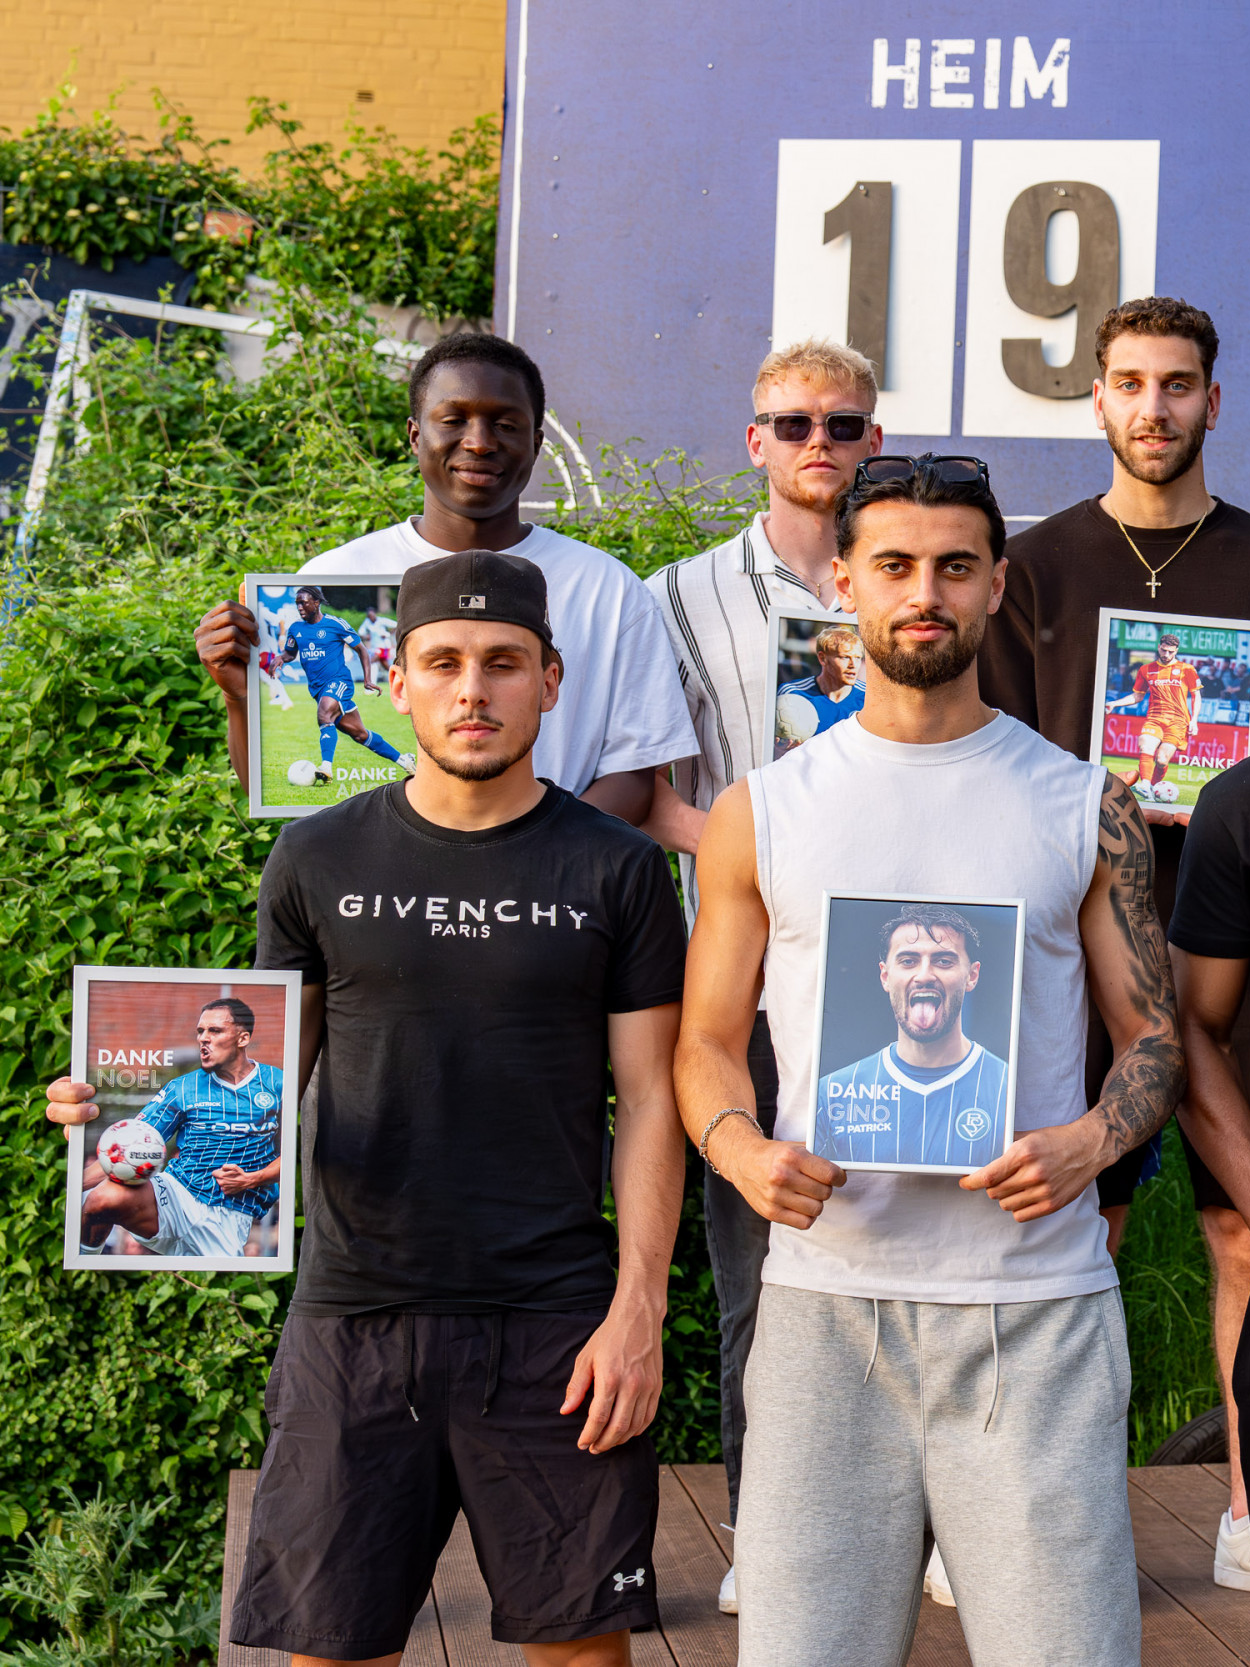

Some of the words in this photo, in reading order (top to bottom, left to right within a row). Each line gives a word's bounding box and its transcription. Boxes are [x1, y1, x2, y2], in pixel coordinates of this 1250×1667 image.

[870, 37, 1071, 110] HEIM
[301, 650, 326, 659] UNION
[336, 767, 397, 781] DANKE
[338, 894, 588, 930] GIVENCHY
[431, 922, 491, 938] PARIS
[97, 1048, 174, 1067] DANKE
[96, 1068, 162, 1089] NOEL
[829, 1081, 902, 1101] DANKE
[828, 1102, 891, 1123] GINO
[847, 1122, 892, 1134] PATRICK
